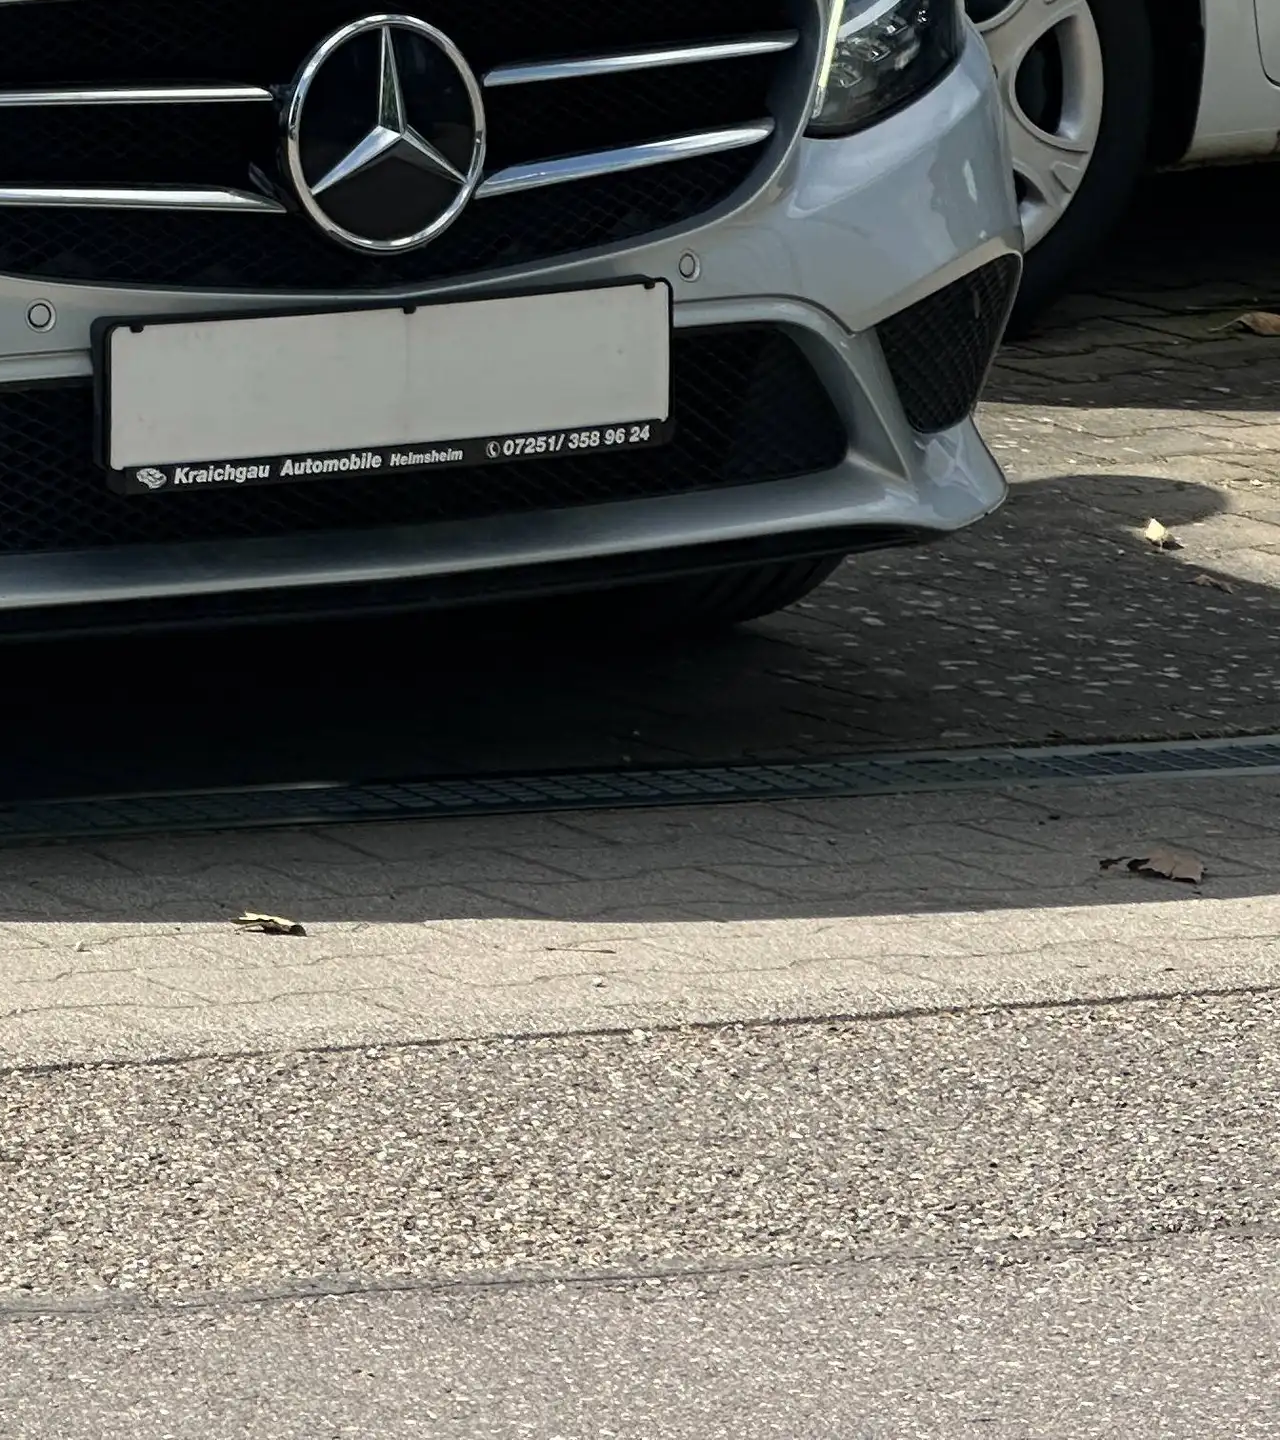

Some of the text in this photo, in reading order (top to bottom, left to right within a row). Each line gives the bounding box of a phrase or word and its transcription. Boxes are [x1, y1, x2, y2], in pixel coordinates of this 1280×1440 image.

[173, 424, 650, 485] Kraichgau Automobile Helmsheim 07251/ 358 96 24
